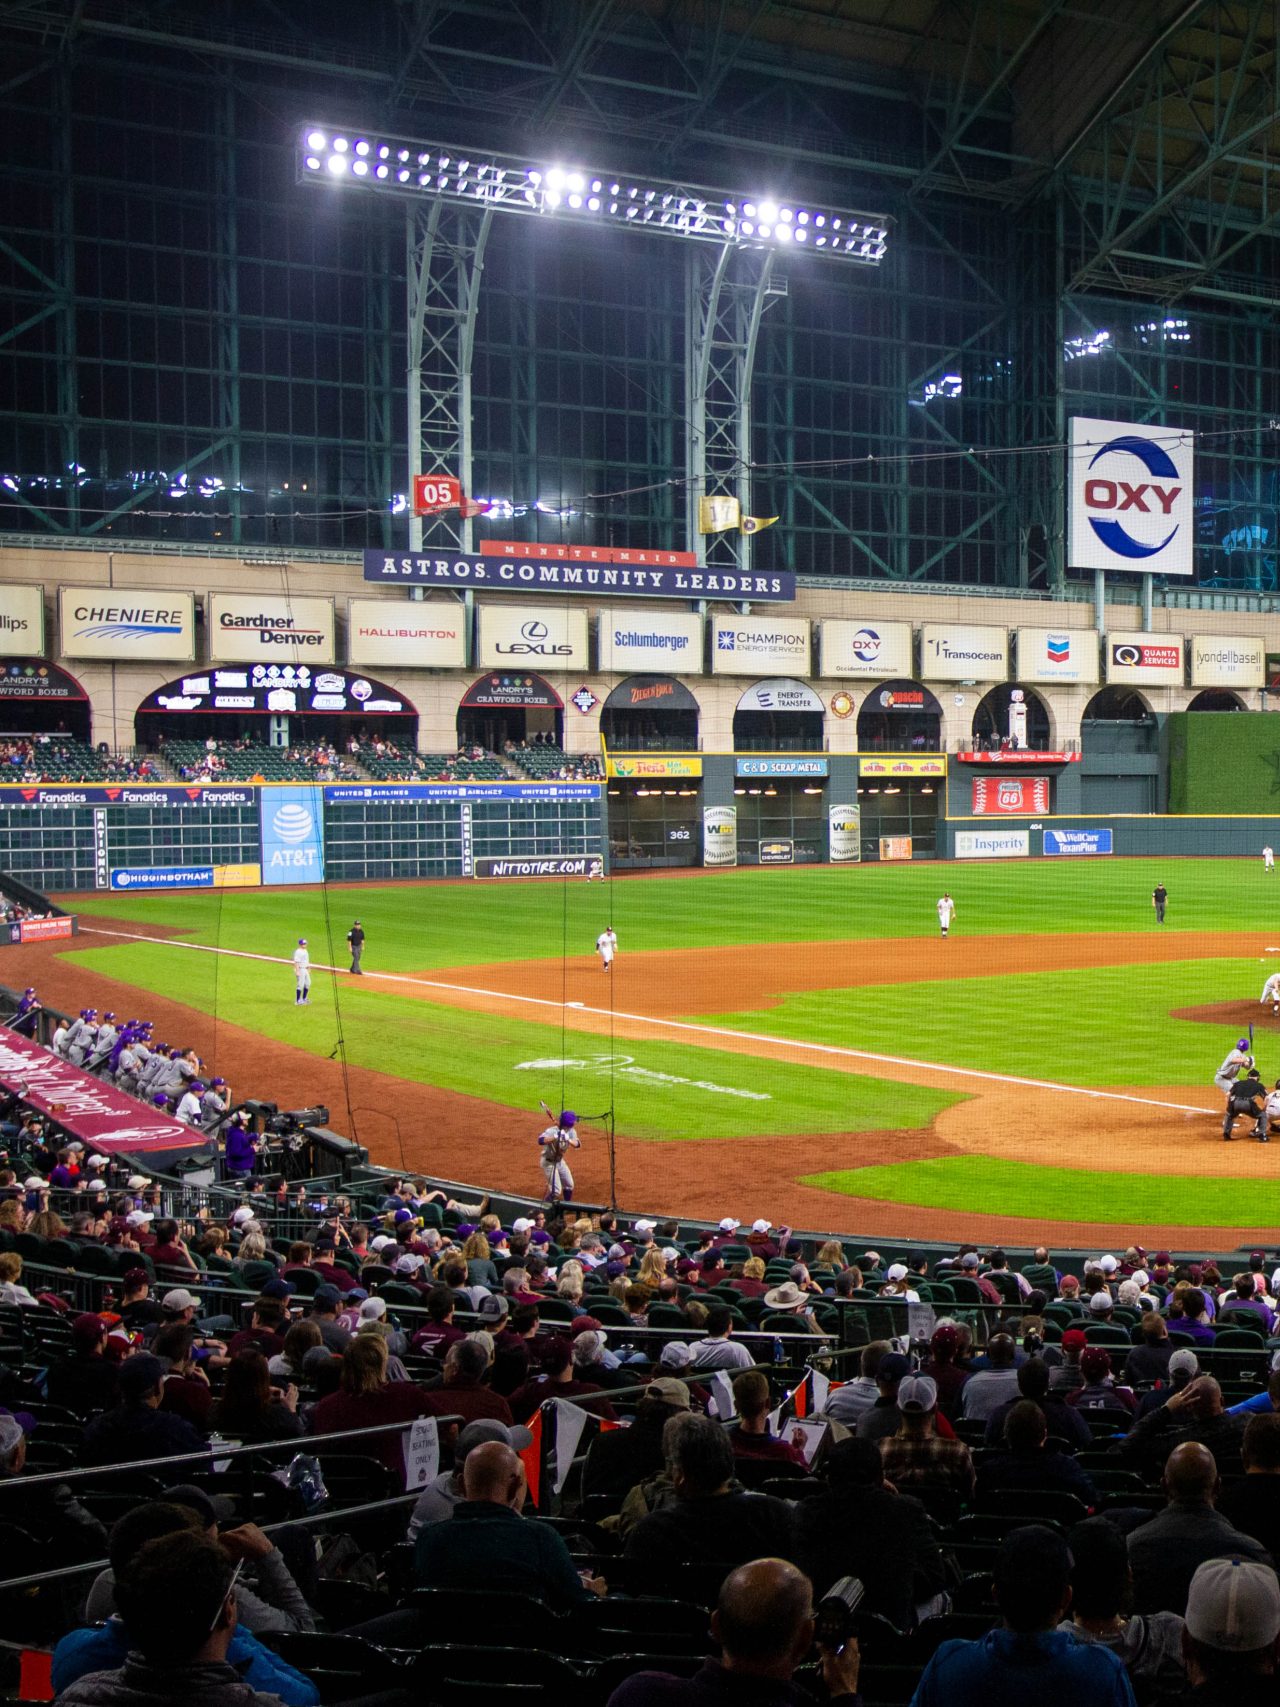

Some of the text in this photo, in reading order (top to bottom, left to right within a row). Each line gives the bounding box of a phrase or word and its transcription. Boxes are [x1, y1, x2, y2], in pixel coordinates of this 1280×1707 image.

[423, 483, 452, 504] 05
[1085, 478, 1182, 514] OXY
[709, 504, 729, 522] 17
[505, 545, 677, 563] MINUTE MAID
[382, 557, 781, 593] ASTROS COMMUNITY LEADERS
[74, 606, 182, 624] CHENIERE
[220, 612, 294, 629] Gardner
[260, 631, 324, 646] Denver
[359, 627, 456, 639] HALLIBURTON
[737, 631, 805, 646] CHAMPION
[614, 631, 689, 652] Schlumberger
[852, 640, 881, 650] OXY
[496, 642, 573, 656] LEXUS
[737, 645, 768, 653] ENERGY
[943, 648, 1002, 661] Transocean
[1143, 650, 1177, 658] QUANTA
[1143, 657, 1177, 665] SERVICES
[1197, 649, 1261, 664] lyondellbasell
[252, 677, 311, 688] LANDRY'S
[38, 688, 69, 696] BOXES
[777, 691, 803, 699] ENERGY
[778, 700, 811, 708] TRANSFER
[771, 762, 796, 773] SCRAP
[798, 762, 822, 773] METAL
[39, 791, 246, 803] Fanatics Fanatics Fanatics
[1002, 792, 1017, 803] 66
[463, 806, 471, 873] AMERICAN
[670, 830, 690, 840] 362
[1066, 832, 1099, 843] WellCare
[97, 811, 105, 886] NATIONAL
[975, 837, 1025, 850] Insperity
[1059, 842, 1097, 852] TexanPlus
[270, 848, 316, 867] AT&T
[492, 859, 585, 876] NITTOTIRE.COM
[131, 873, 208, 881] HIGGINBOTHAM
[415, 1455, 431, 1466] ONLY
